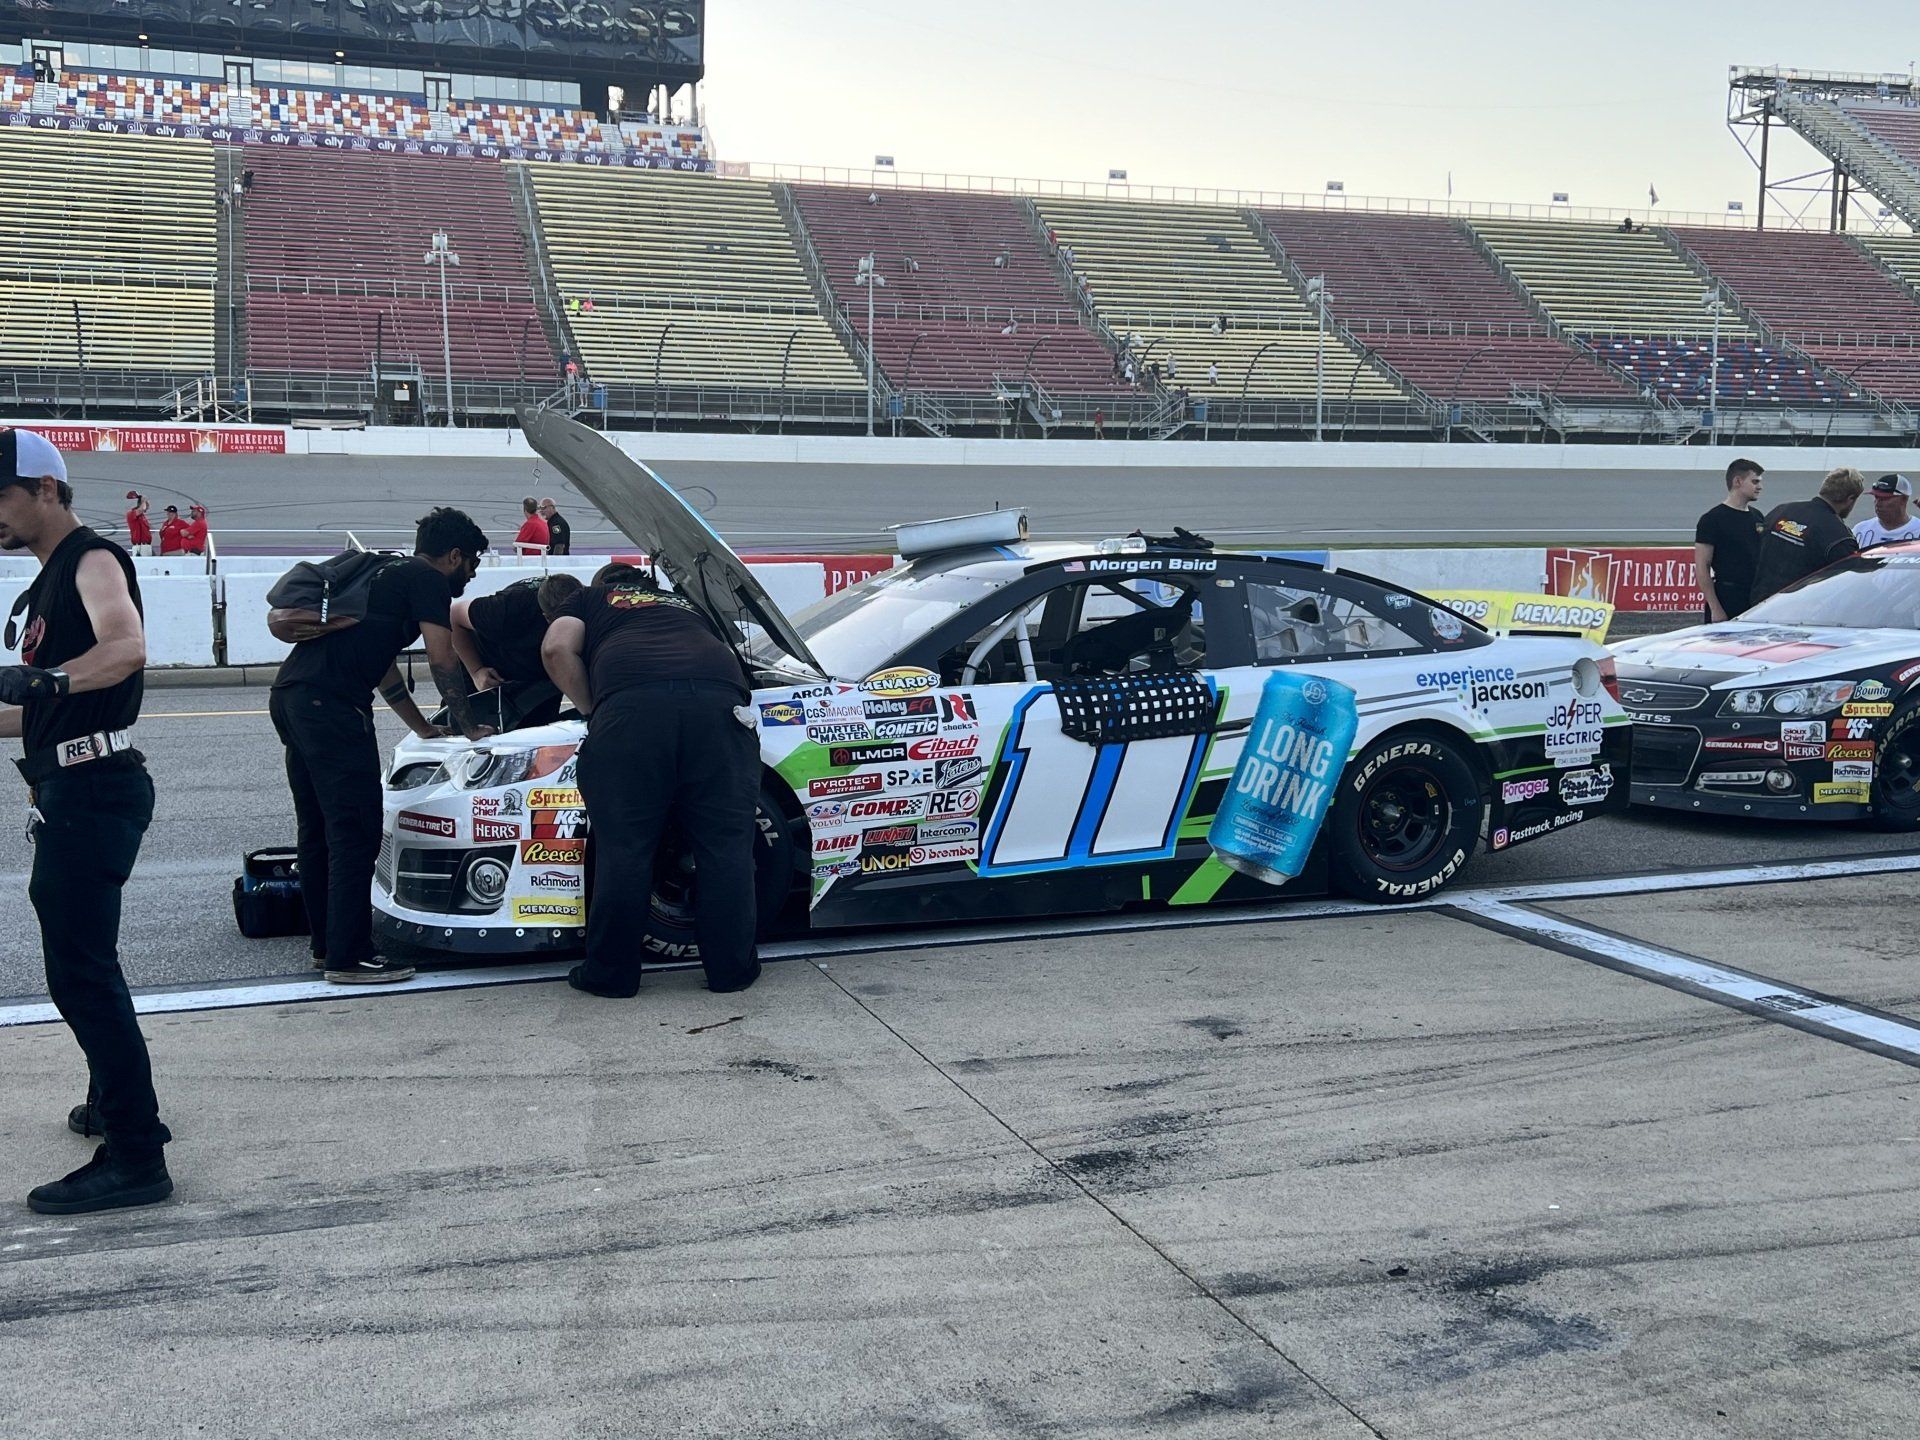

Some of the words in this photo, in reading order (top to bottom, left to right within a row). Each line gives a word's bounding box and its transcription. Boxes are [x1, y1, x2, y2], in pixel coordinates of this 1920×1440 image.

[40, 117, 60, 130] ally
[98, 121, 119, 134] ally
[156, 126, 176, 138] ally
[212, 129, 232, 141] ally
[271, 134, 290, 145] ally
[324, 137, 344, 149] ally
[378, 141, 396, 152] ally
[430, 144, 448, 155] ally
[481, 147, 500, 158] ally
[535, 151, 552, 162] ally
[584, 154, 601, 166] ally
[633, 157, 650, 169] ally
[681, 161, 698, 172] ally
[1090, 560, 1162, 573] Morgen
[1169, 558, 1217, 571] Baird
[1633, 592, 1679, 602] CASINO
[1646, 603, 1679, 611] BATTLE
[1684, 603, 1705, 611] CREE
[1511, 602, 1607, 628] MENARDS
[858, 674, 940, 692] MENARDS
[1416, 665, 1515, 691] experience
[791, 686, 834, 700] ARCA
[1471, 680, 1546, 709] jackson
[1853, 685, 1891, 700] Bounty
[763, 708, 803, 717] SUNOCO
[863, 699, 908, 716] Holley
[1844, 703, 1892, 716] Sprecher
[1654, 714, 1671, 724] SS
[875, 719, 938, 738] COMETIC
[942, 721, 973, 732] shocks
[1783, 727, 1807, 735] Sioux
[820, 731, 869, 744] MASTER
[1546, 729, 1602, 747] ELECTRIC
[908, 734, 979, 760] Eibach
[1256, 718, 1334, 779] LONG
[1705, 741, 1743, 749] GENERAL
[1743, 741, 1764, 749] TIRE
[1788, 746, 1821, 757] HERR'S
[1827, 744, 1873, 759] Reese's
[851, 748, 905, 760] ILMOR
[1834, 767, 1871, 776] Richmond
[812, 776, 879, 790] PYROTECT
[1236, 758, 1328, 820] DRINK
[1503, 779, 1548, 798] Forager
[530, 789, 584, 806] Sprech
[1819, 788, 1864, 796] MENARDS
[472, 796, 500, 806] Sioux
[850, 799, 908, 817] COMP
[472, 806, 498, 816] Chief
[889, 808, 917, 816] CAMS
[398, 816, 425, 829] GENERAL
[425, 821, 441, 832] TIRE
[811, 819, 841, 828] VOLVO
[1510, 809, 1584, 843] Fasttrack_Racing
[475, 823, 516, 839] HERR'S
[920, 827, 971, 839] Intercomp
[523, 841, 582, 862] Reese's
[928, 846, 975, 860] brembo
[862, 853, 911, 872] UNOH
[1376, 848, 1466, 896] GENERAL
[530, 875, 581, 888] Richmond
[518, 905, 578, 915] MENARDS
